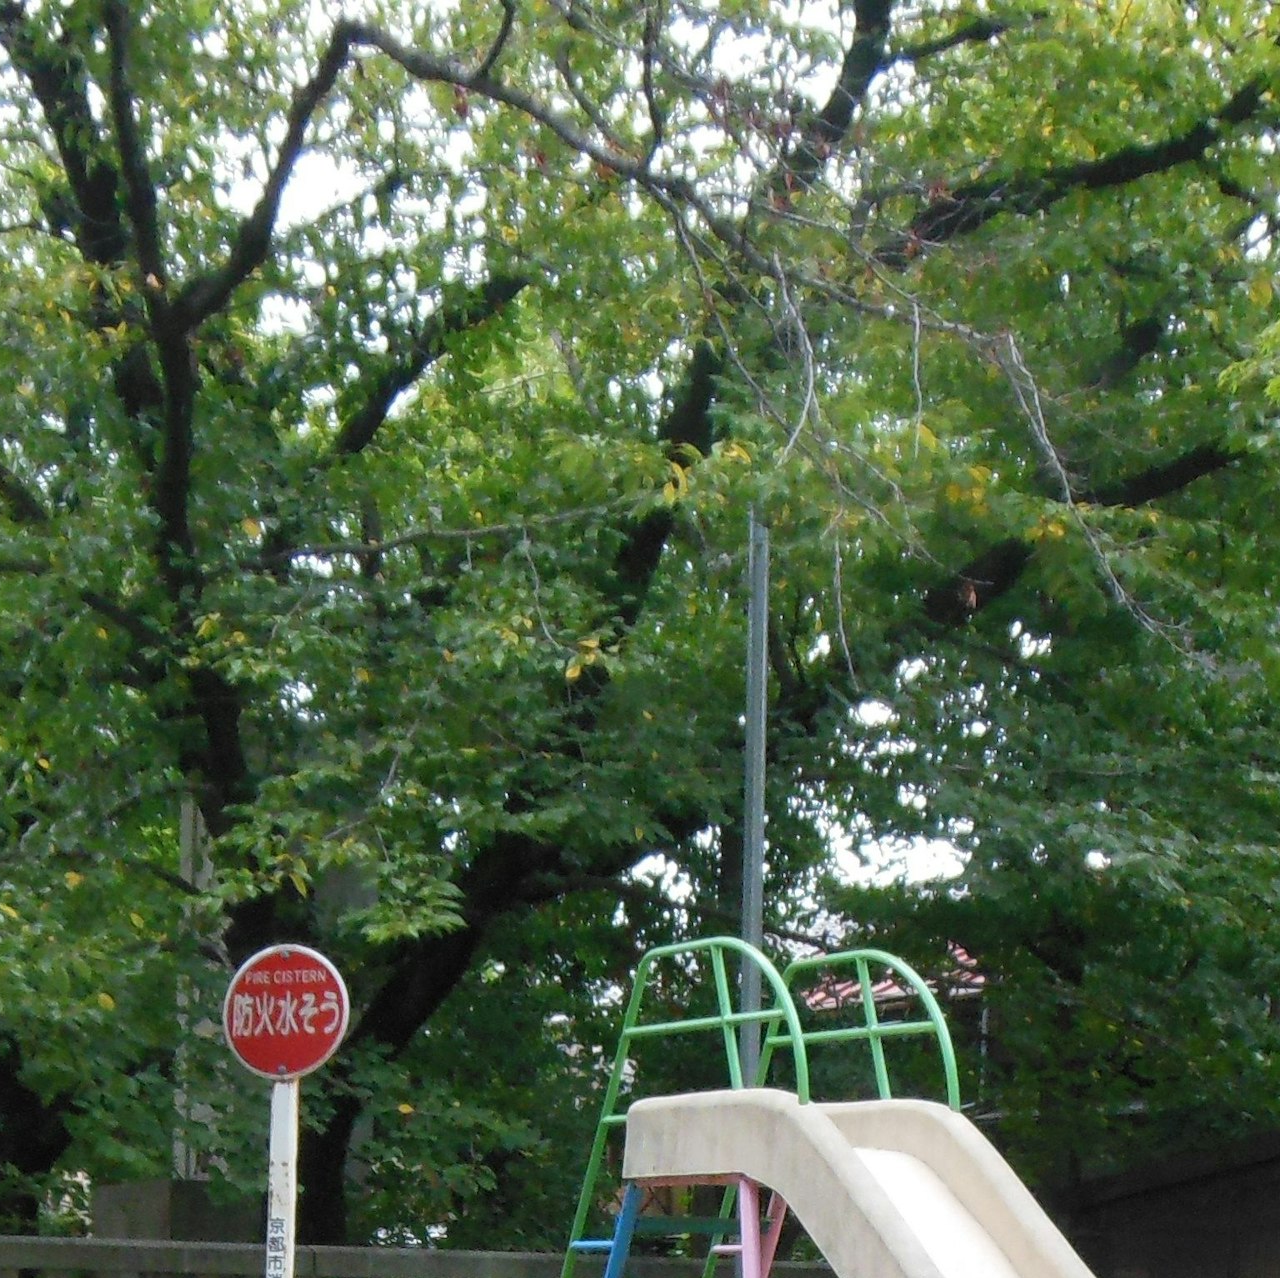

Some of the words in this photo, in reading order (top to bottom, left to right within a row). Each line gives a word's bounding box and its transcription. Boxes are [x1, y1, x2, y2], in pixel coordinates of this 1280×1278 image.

[245, 970, 270, 984] FIRE
[273, 969, 327, 984] CISTERN
[232, 990, 340, 1037] 防火水そう
